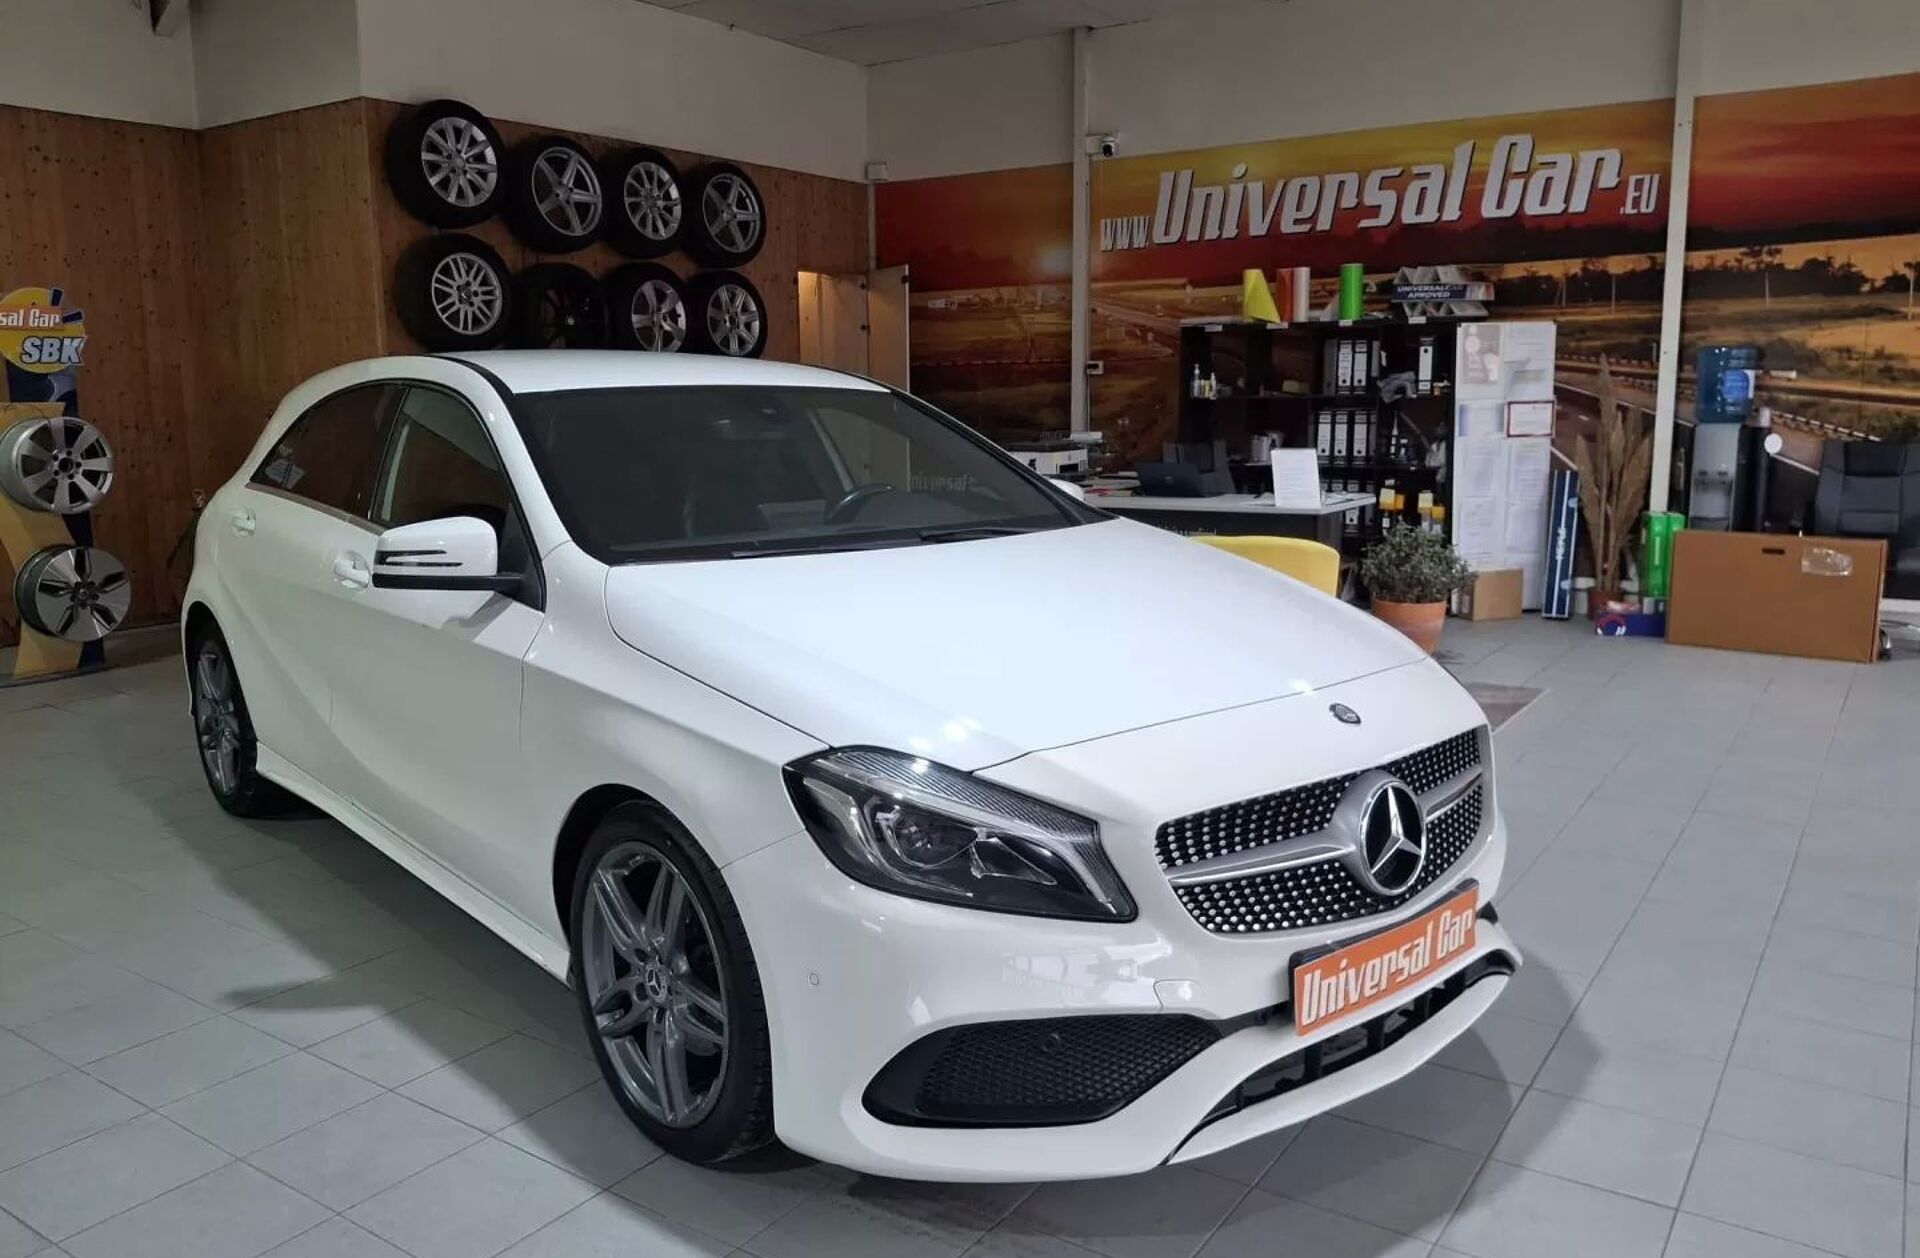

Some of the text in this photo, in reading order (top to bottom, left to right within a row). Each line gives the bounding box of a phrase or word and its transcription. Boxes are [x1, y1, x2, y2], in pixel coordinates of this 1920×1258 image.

[29, 308, 60, 327] Car
[21, 336, 82, 363] SBK
[1302, 909, 1474, 1026] Universal Car
